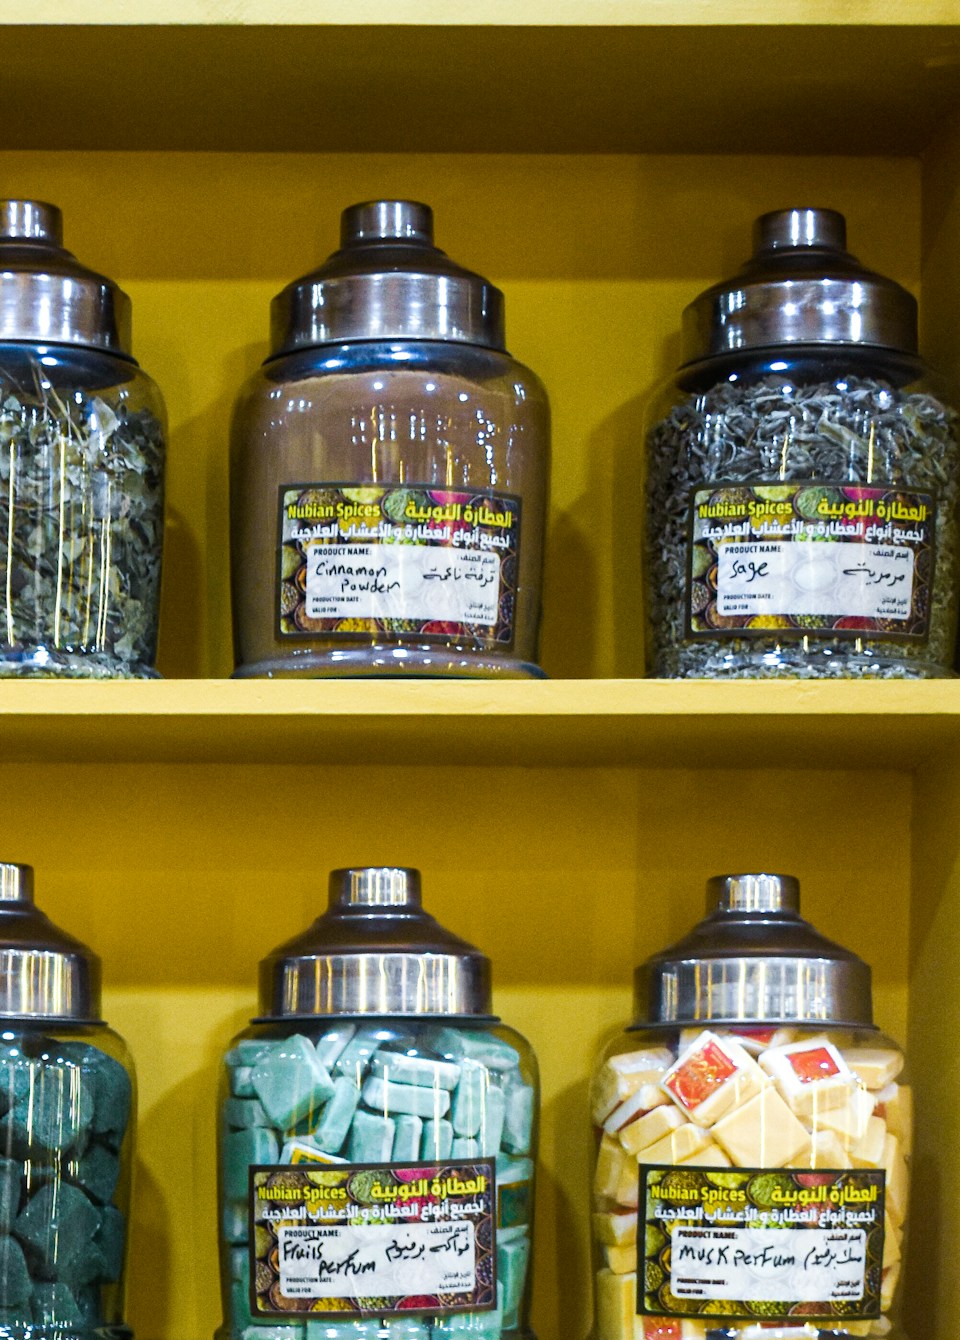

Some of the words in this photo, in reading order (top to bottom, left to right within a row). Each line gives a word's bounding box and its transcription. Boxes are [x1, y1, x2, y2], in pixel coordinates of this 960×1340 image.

[288, 505, 333, 520] Nubian
[337, 503, 380, 521] Spices
[406, 501, 460, 522] النوبية
[464, 504, 512, 528] العطارة
[699, 503, 746, 519] Nubian
[748, 501, 792, 518] Spices
[818, 497, 874, 518] النوبية
[878, 500, 926, 522] العطارة
[725, 546, 757, 554] PRODUCT
[315, 560, 387, 577] Cinnamon
[730, 560, 769, 582] Sage
[341, 579, 400, 593] Powder
[258, 1185, 301, 1200] Nubian
[304, 1186, 346, 1205] Spices
[371, 1182, 427, 1201] النوبية
[431, 1177, 485, 1201] العطارة
[651, 1185, 698, 1200] Nubian
[701, 1187, 745, 1203] Spices
[772, 1186, 827, 1204] النوبية
[830, 1185, 877, 1204] العطارة
